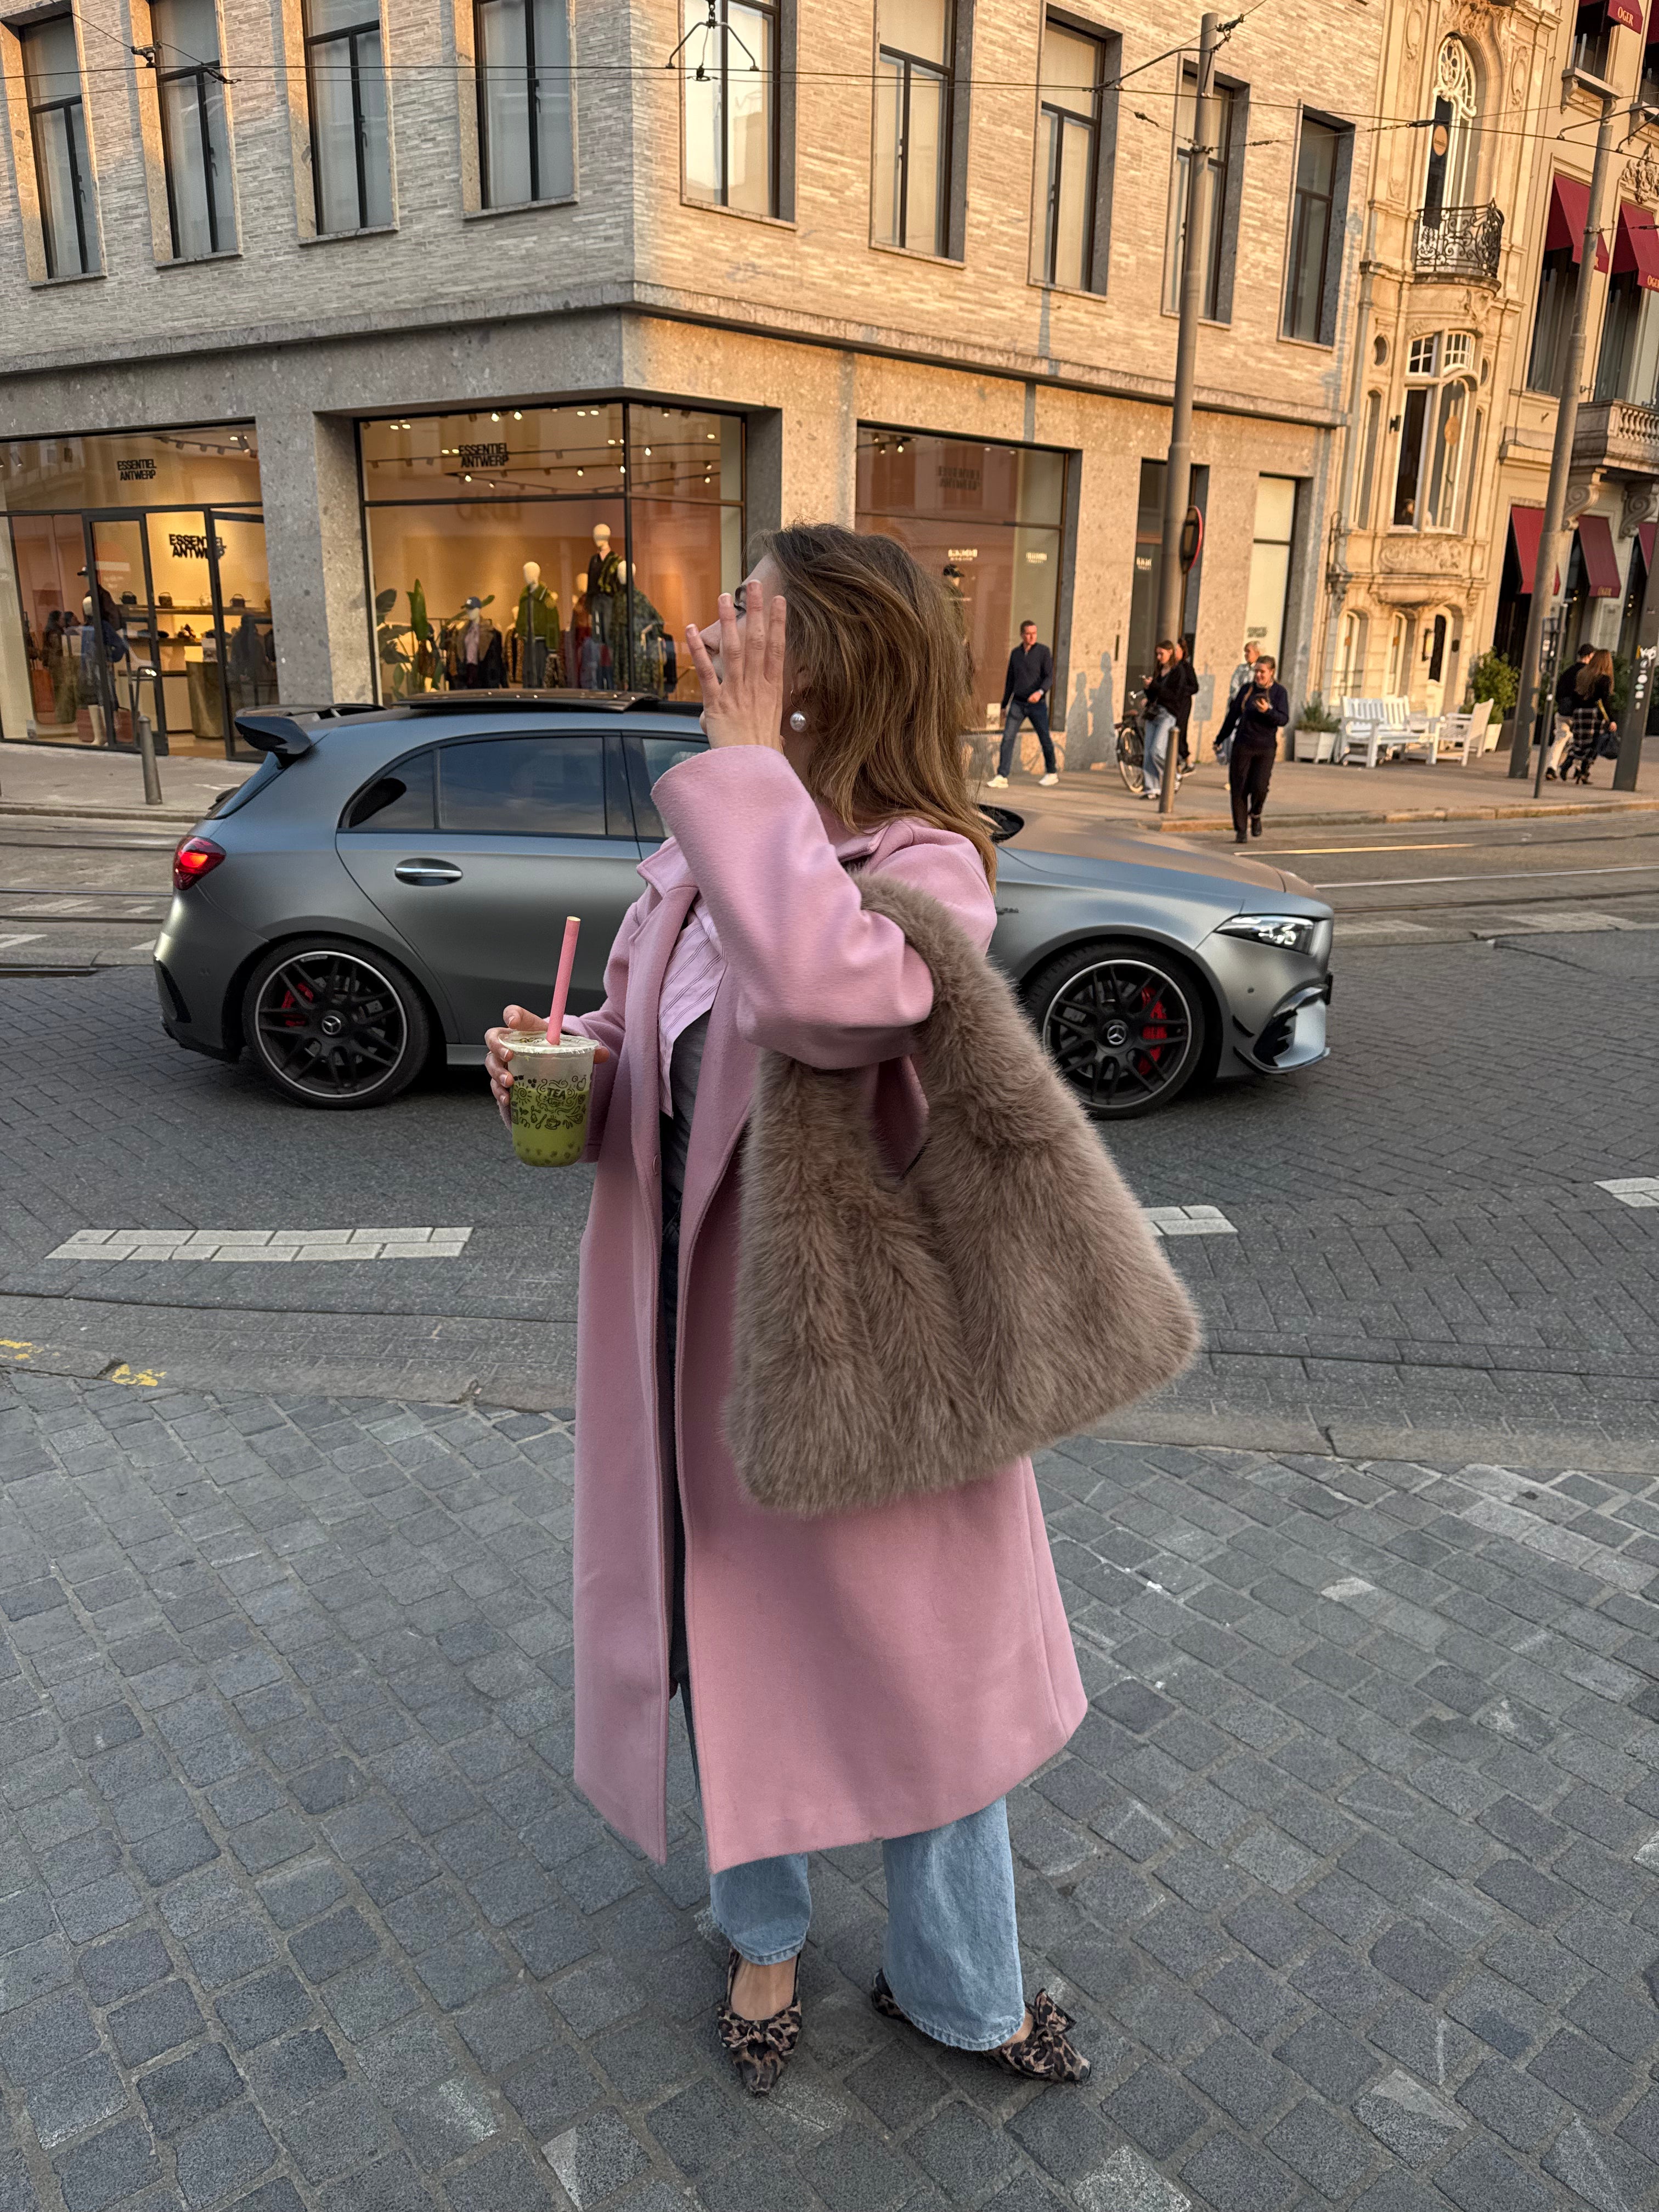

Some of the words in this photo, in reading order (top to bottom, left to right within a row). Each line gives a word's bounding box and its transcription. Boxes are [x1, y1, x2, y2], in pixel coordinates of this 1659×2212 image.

[1617, 6, 1634, 27] OGER
[459, 442, 509, 456] ESSENTIEL
[117, 459, 157, 471] ESSENTIEL
[461, 454, 509, 468] ANTWERP
[120, 469, 156, 481] ANTWERP
[547, 1087, 565, 1100] TEA
